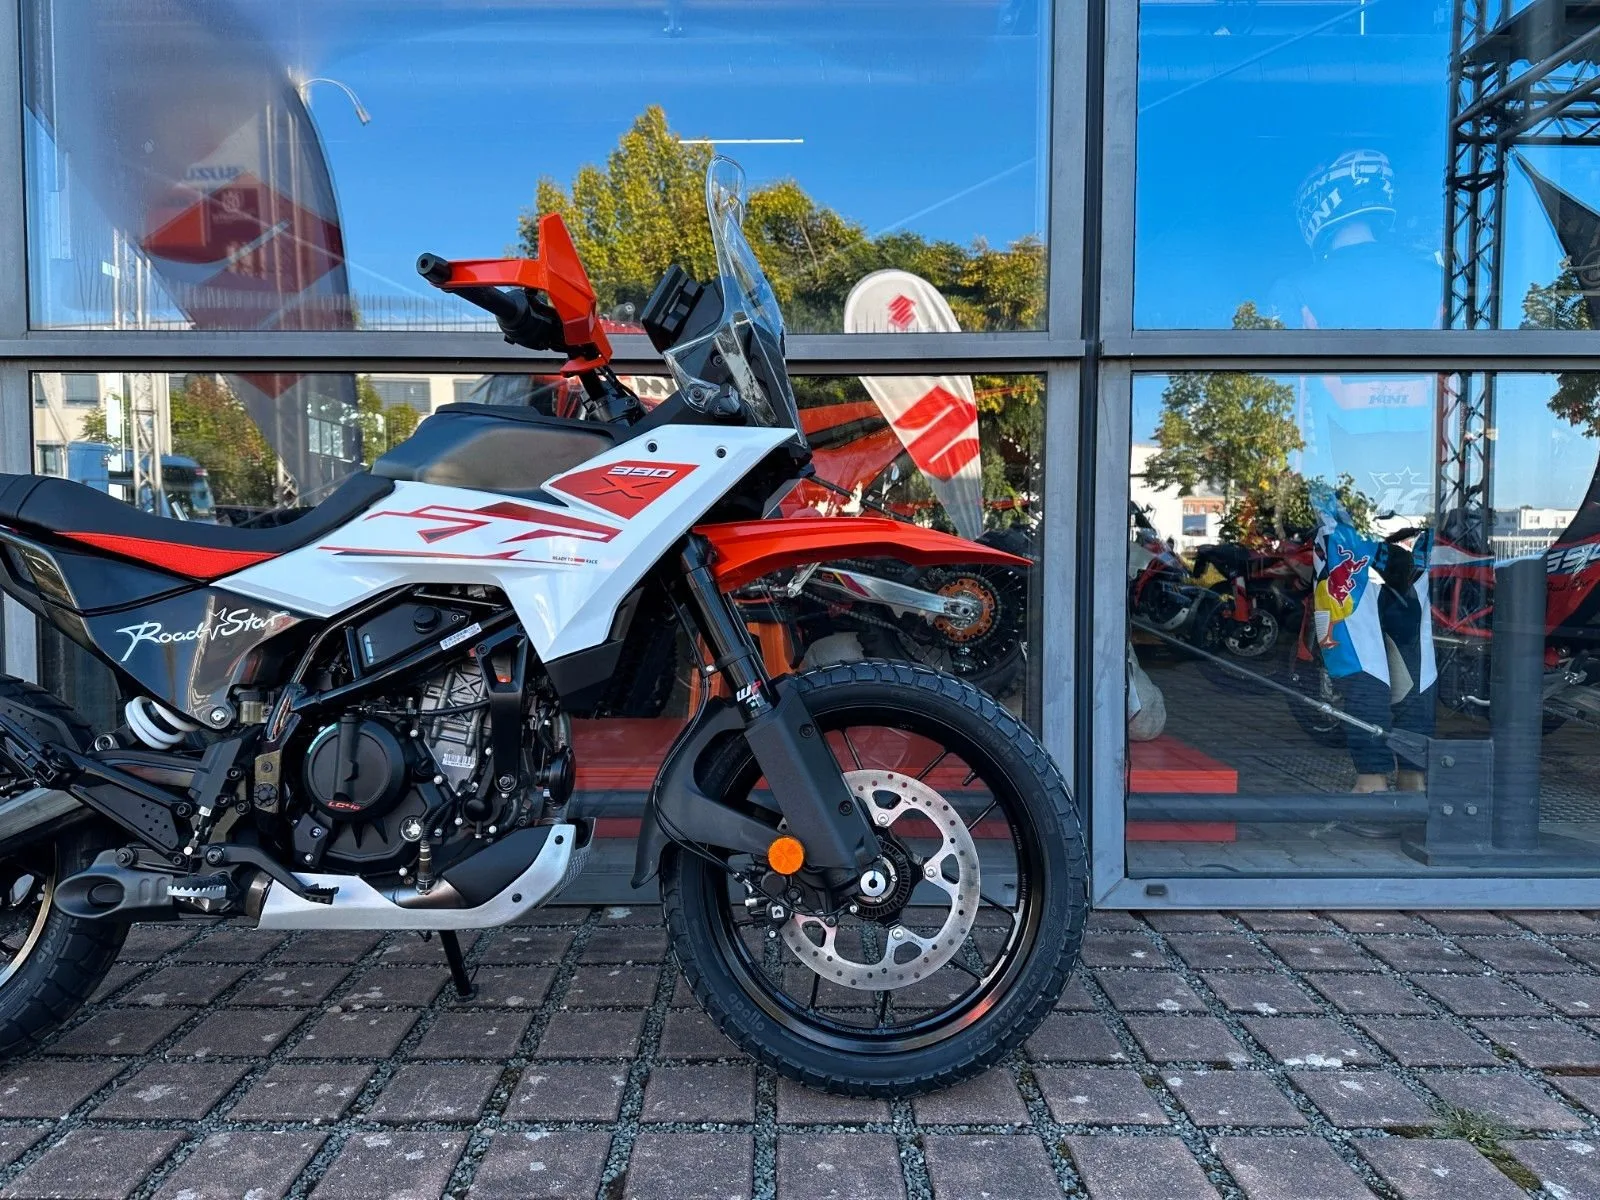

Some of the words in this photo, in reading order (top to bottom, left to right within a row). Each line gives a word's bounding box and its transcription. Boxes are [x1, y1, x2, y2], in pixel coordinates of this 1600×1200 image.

[606, 465, 678, 479] 390
[116, 621, 206, 662] Road
[220, 608, 290, 637] Star
[728, 992, 766, 1032] apollo
